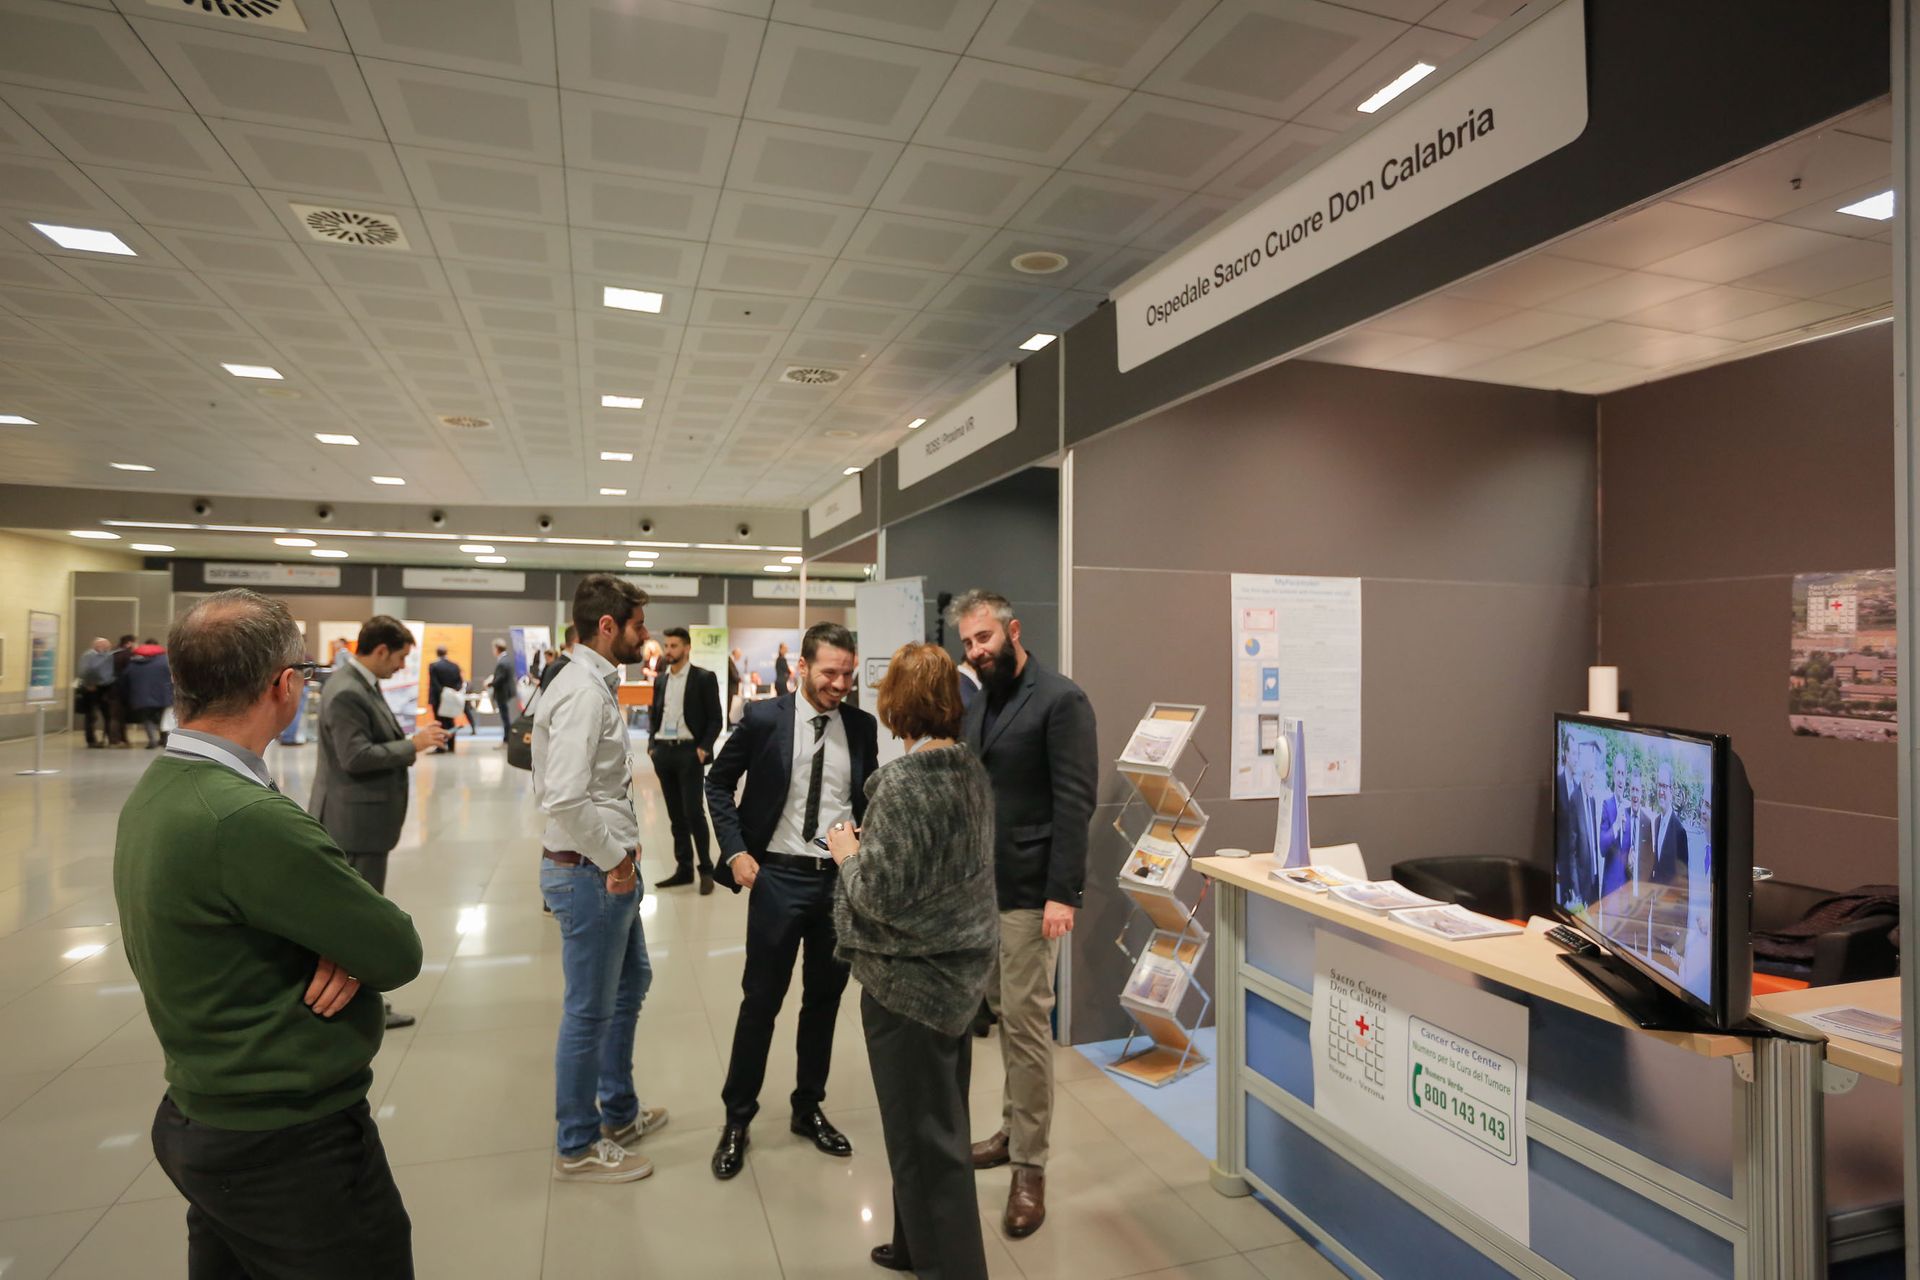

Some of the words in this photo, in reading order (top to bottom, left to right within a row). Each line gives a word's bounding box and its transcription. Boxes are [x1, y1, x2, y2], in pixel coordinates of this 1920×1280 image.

[1146, 274, 1210, 327] Ospedale
[1214, 247, 1262, 290] Sacro
[1265, 210, 1324, 258] Cuore
[1328, 180, 1375, 223] Don
[1380, 107, 1495, 191] Calabria
[772, 583, 837, 596] ANHEA
[1330, 967, 1355, 988] Sacro
[1358, 980, 1387, 1002] Cuore
[1330, 979, 1348, 996] Don
[1350, 989, 1386, 1014] Calabria
[1412, 1040, 1436, 1059] Numero
[1437, 1053, 1449, 1065] per
[1449, 1057, 1455, 1069] la
[1456, 1061, 1472, 1077] Cura
[1472, 1067, 1483, 1081] del
[1484, 1073, 1512, 1096] Tumore
[1420, 1027, 1449, 1047] Cancer
[1450, 1040, 1470, 1057] Care
[1471, 1050, 1502, 1072] Center
[1425, 1066, 1446, 1084] Numero
[1447, 1078, 1464, 1093] Verde
[1425, 1083, 1447, 1110] 800
[1451, 1097, 1475, 1125] 143
[1479, 1112, 1505, 1141] 143
